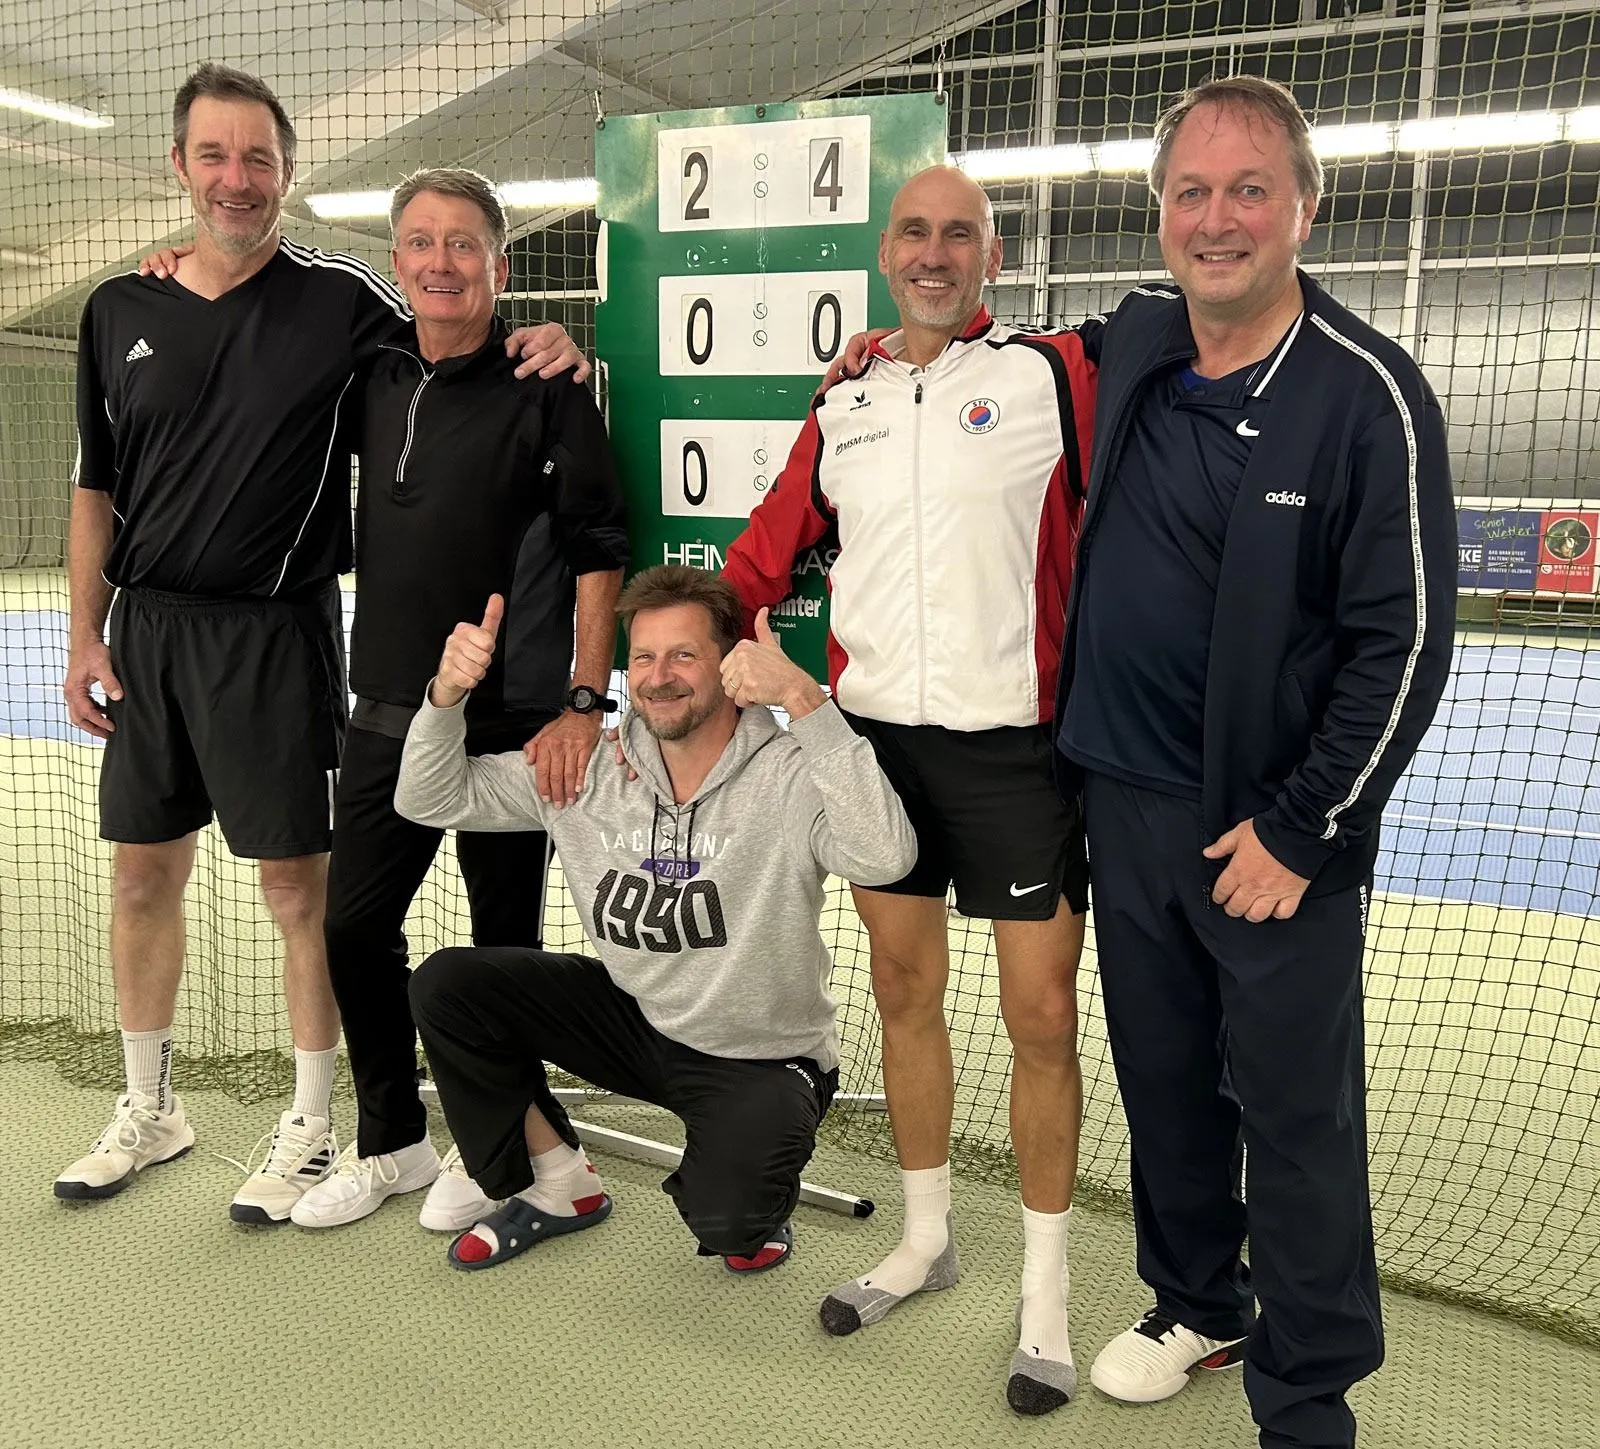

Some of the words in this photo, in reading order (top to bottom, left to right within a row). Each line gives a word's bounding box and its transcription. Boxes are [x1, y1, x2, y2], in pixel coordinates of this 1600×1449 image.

[684, 152, 709, 220] 2
[813, 142, 843, 212] 4
[126, 349, 154, 362] adidas
[686, 298, 713, 365] 0
[812, 293, 841, 363] 0
[683, 440, 708, 506] 0
[1458, 549, 1482, 563] KE
[655, 863, 690, 878] CORE
[593, 868, 728, 954] 1990
